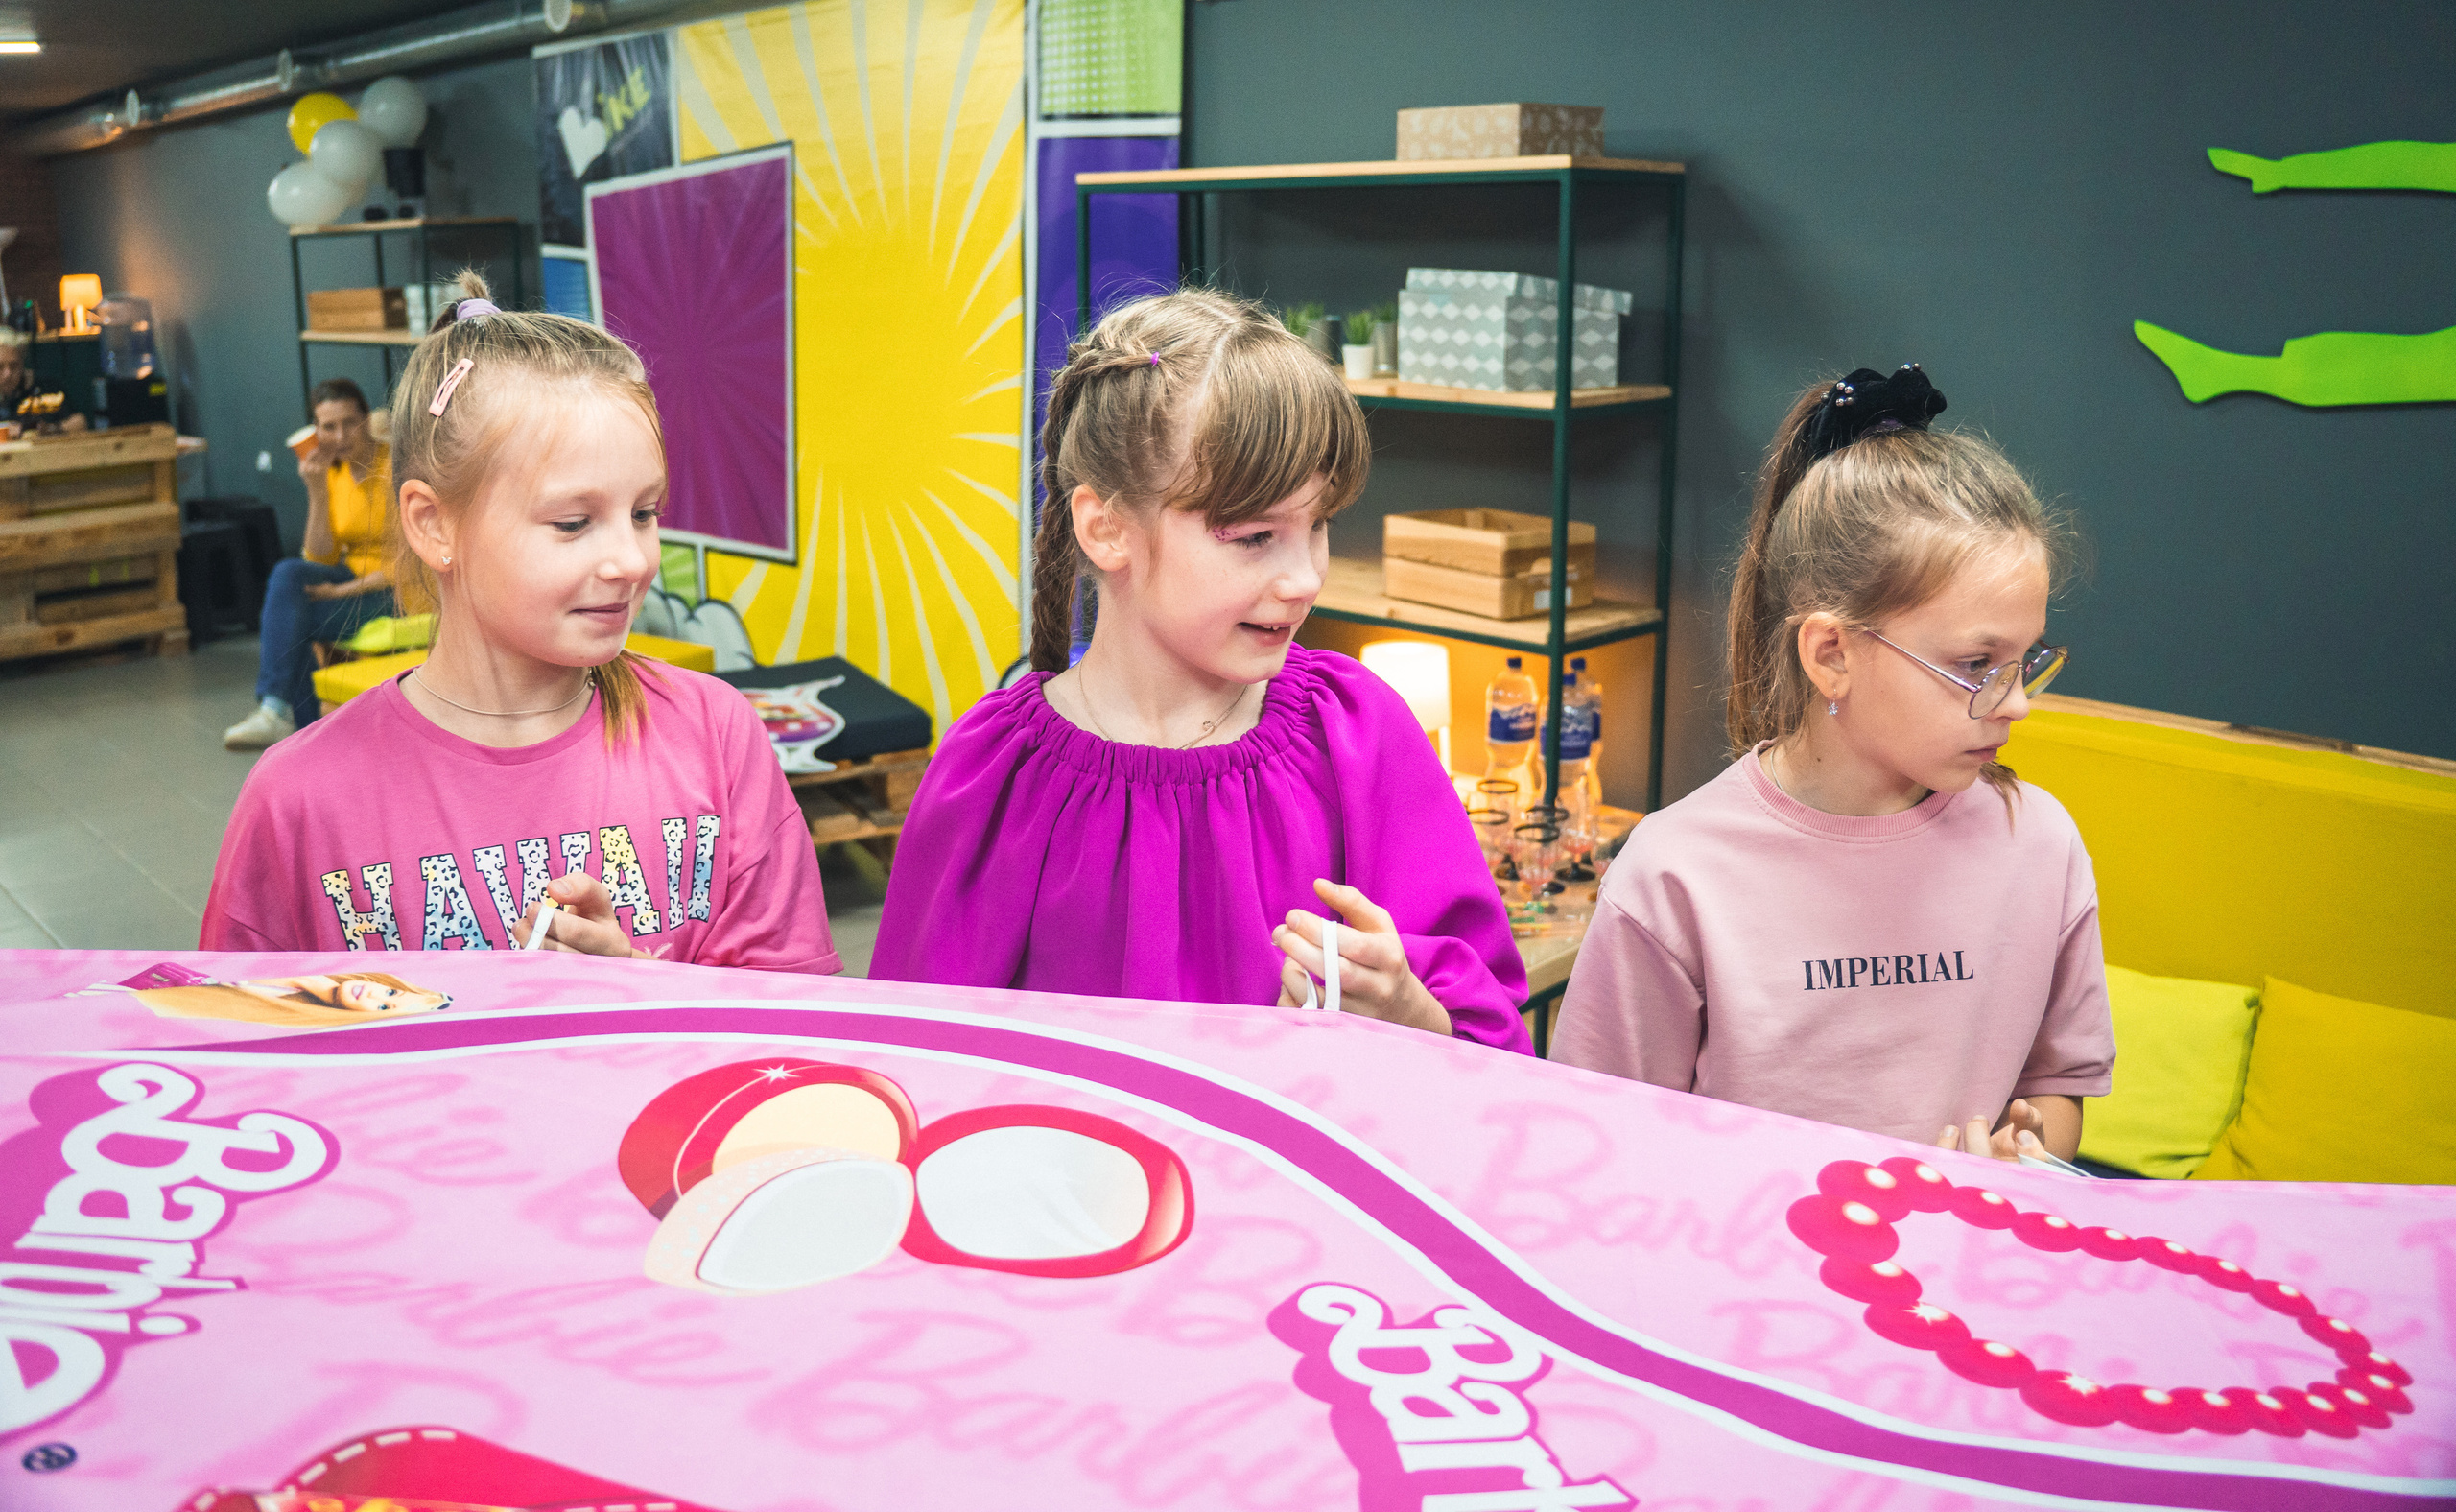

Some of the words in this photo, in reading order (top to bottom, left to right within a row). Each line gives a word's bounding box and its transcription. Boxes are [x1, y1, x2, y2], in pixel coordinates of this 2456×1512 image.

[320, 815, 720, 951] HAWAII
[1802, 950, 1974, 991] IMPERIAL
[1297, 1284, 1632, 1512] Bar
